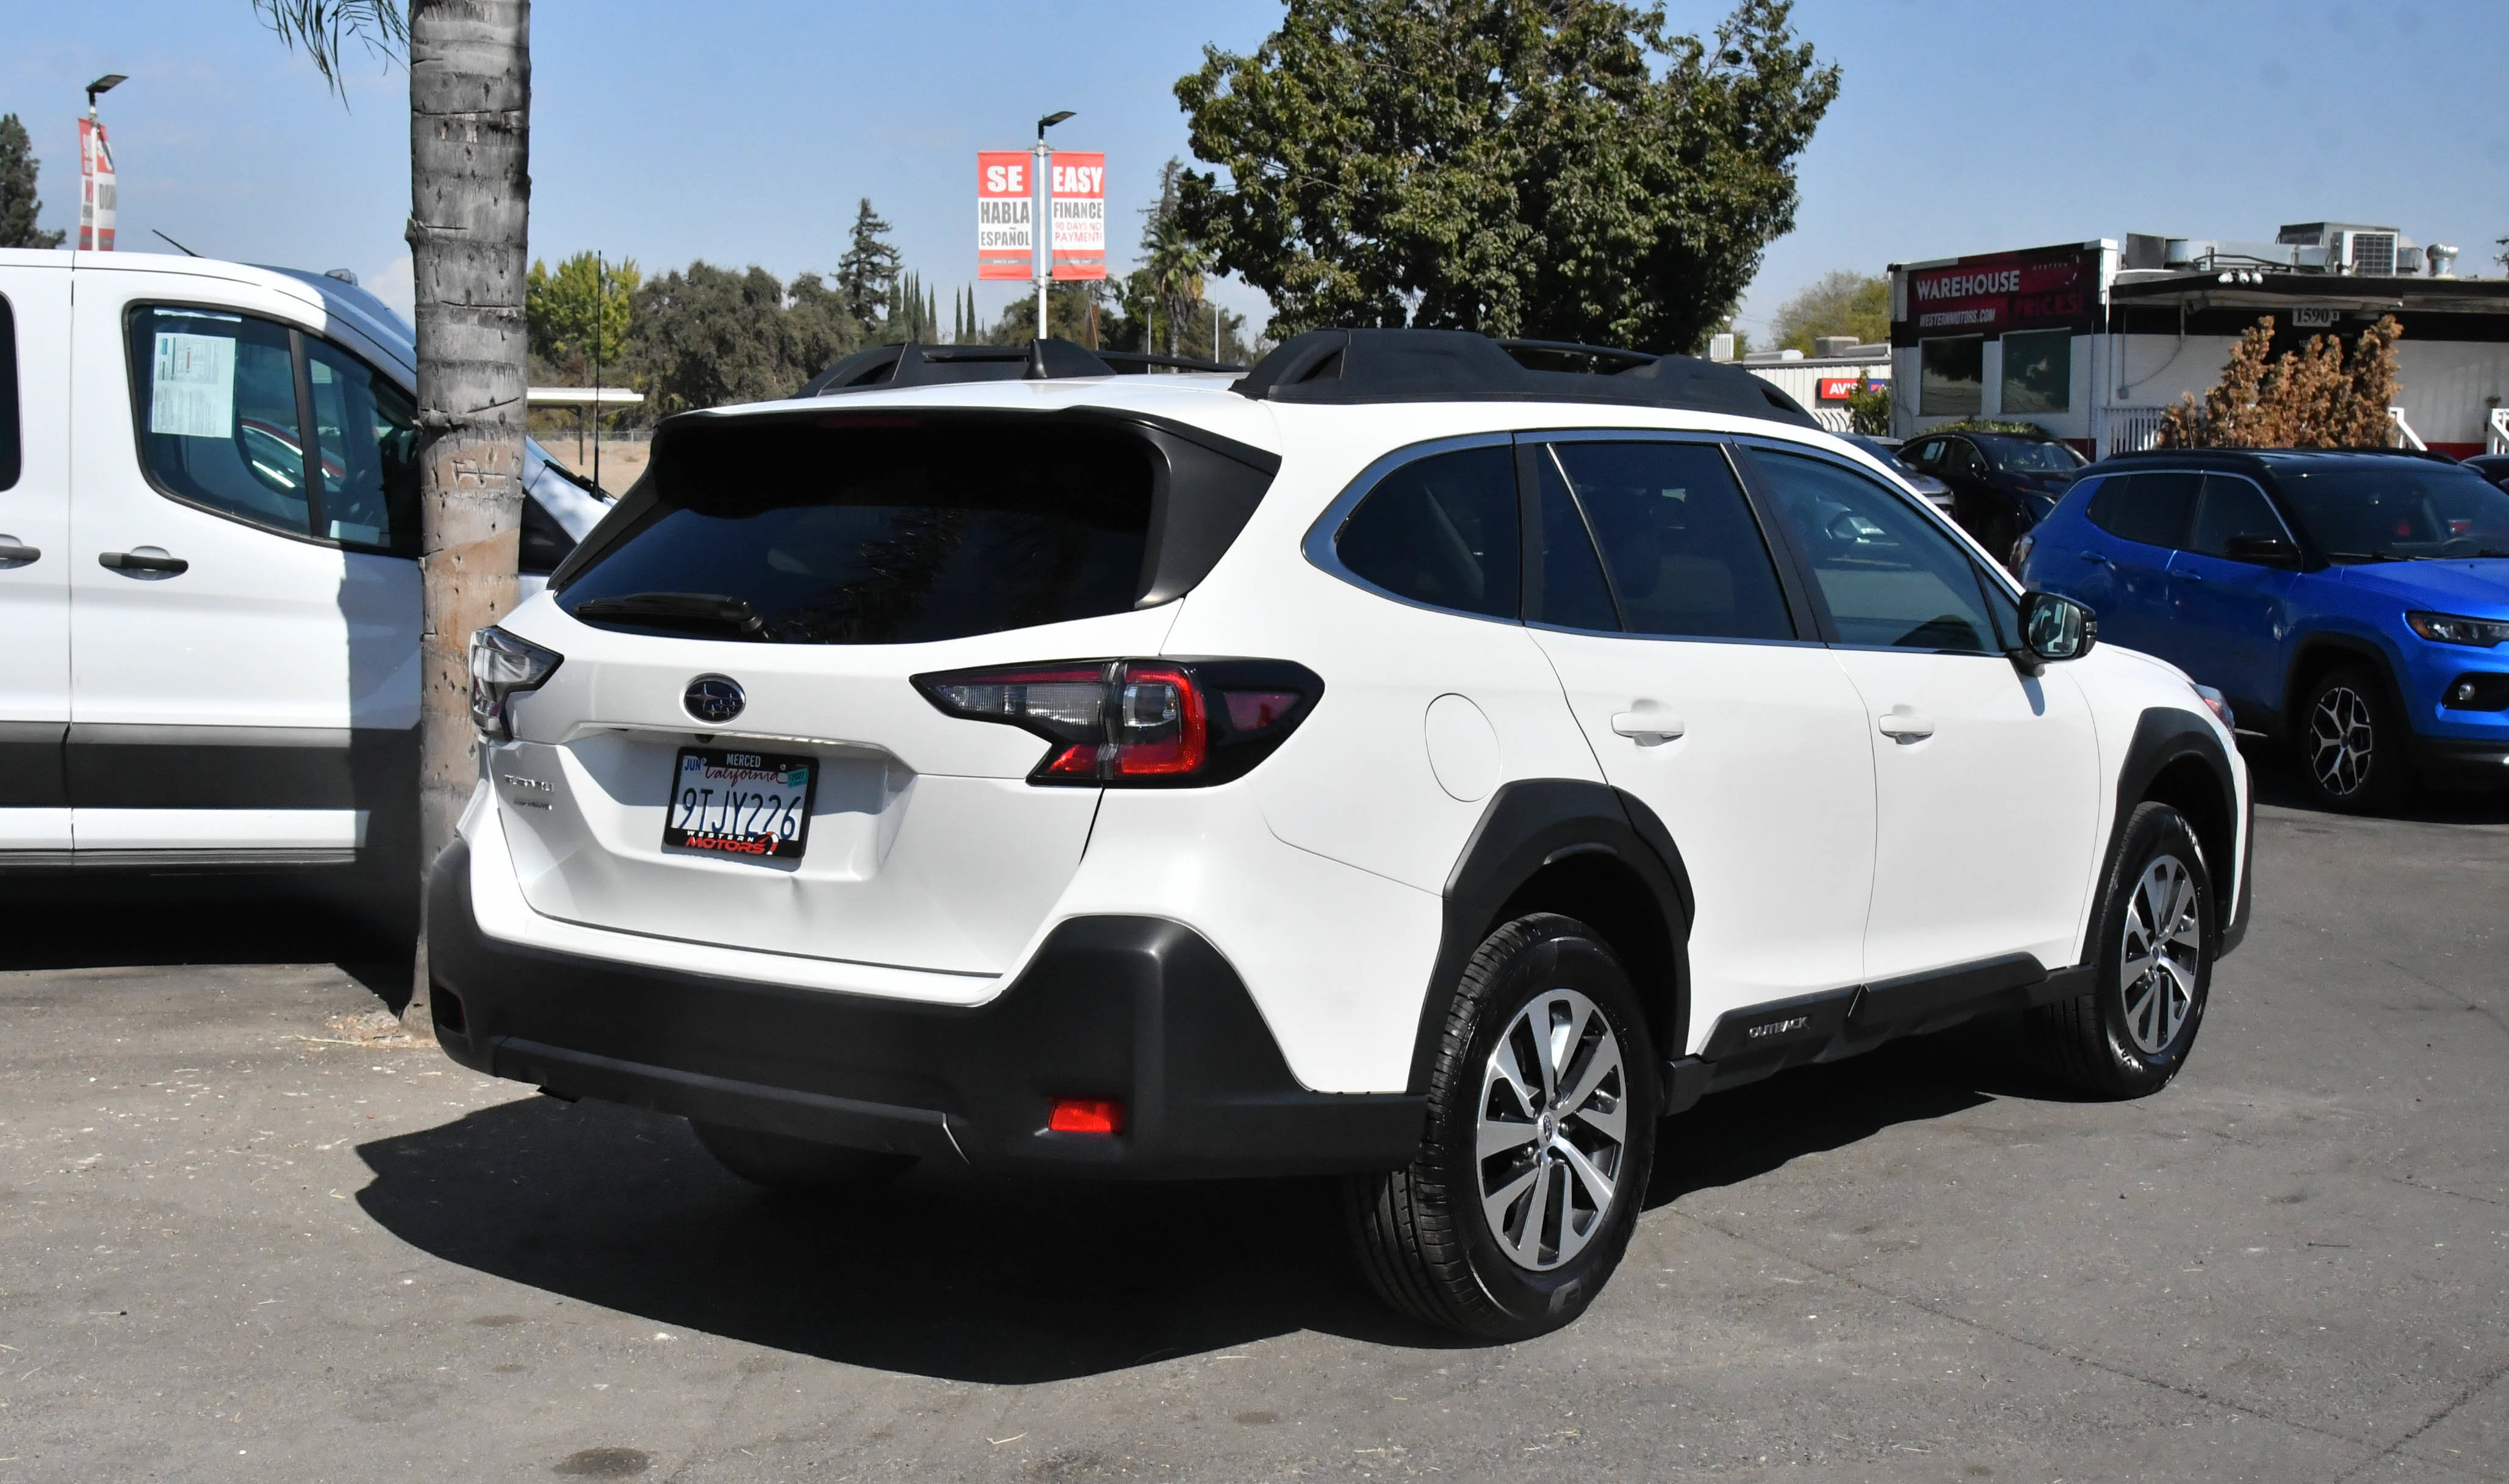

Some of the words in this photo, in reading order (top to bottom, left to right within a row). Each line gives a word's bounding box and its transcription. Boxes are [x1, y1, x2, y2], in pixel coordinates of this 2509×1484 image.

[987, 165, 1023, 192] SE
[1053, 166, 1103, 193] EASY
[981, 201, 1030, 224] HABLA
[1053, 202, 1102, 219] FINANCE
[981, 226, 1030, 247] ESPAÑOL
[1054, 222, 1065, 231] 90
[1067, 222, 1087, 230] DAYS
[1089, 222, 1102, 231] NO
[1917, 270, 2020, 301] WAREHOUSE
[1919, 308, 1996, 328] WESTERNMOTORS.COM
[2296, 308, 2330, 323] 1590
[684, 758, 701, 772] JUN
[726, 753, 761, 768] MERCED
[705, 765, 788, 787] California
[679, 787, 801, 840] 9TJY226
[685, 836, 765, 854] MOTORS
[686, 830, 755, 843] WESTERN
[1749, 1016, 1811, 1039] OUTBACK
